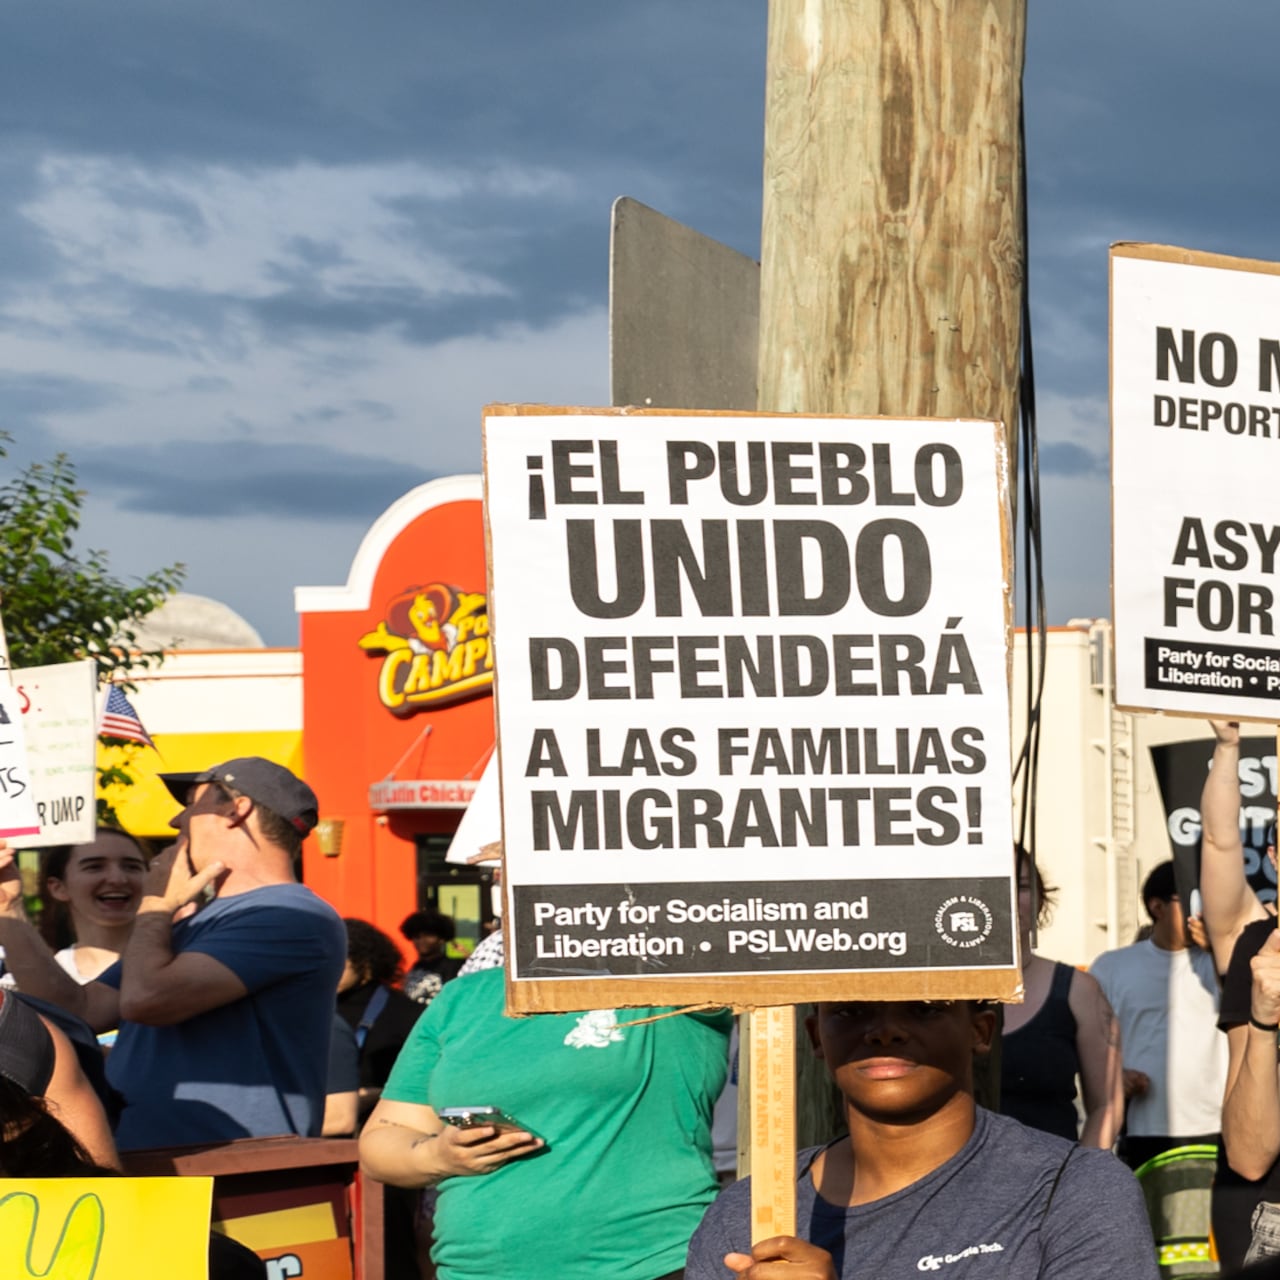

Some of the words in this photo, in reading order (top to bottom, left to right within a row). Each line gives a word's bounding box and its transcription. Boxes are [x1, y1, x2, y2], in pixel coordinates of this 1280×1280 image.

[1156, 326, 1238, 388] NO
[526, 440, 645, 519] ¡EL
[666, 441, 964, 506] PUEBLO
[566, 518, 932, 619] UNIDO
[1163, 576, 1274, 636] FOR
[529, 617, 983, 700] DEFENDERÁ
[1158, 648, 1202, 670] Party
[1205, 651, 1231, 670] for
[1158, 667, 1243, 690] Liberation
[525, 729, 568, 777] A
[587, 728, 697, 777] LAS
[718, 727, 986, 776] FAMILIAS
[37, 796, 84, 826] RUMP
[530, 787, 984, 850] MIGRANTES!
[534, 903, 611, 930] Party
[618, 900, 660, 924] for
[666, 899, 808, 923] Socialism
[813, 898, 868, 919] and
[536, 934, 683, 958] Liberation
[728, 929, 907, 955] PSLWeb.org
